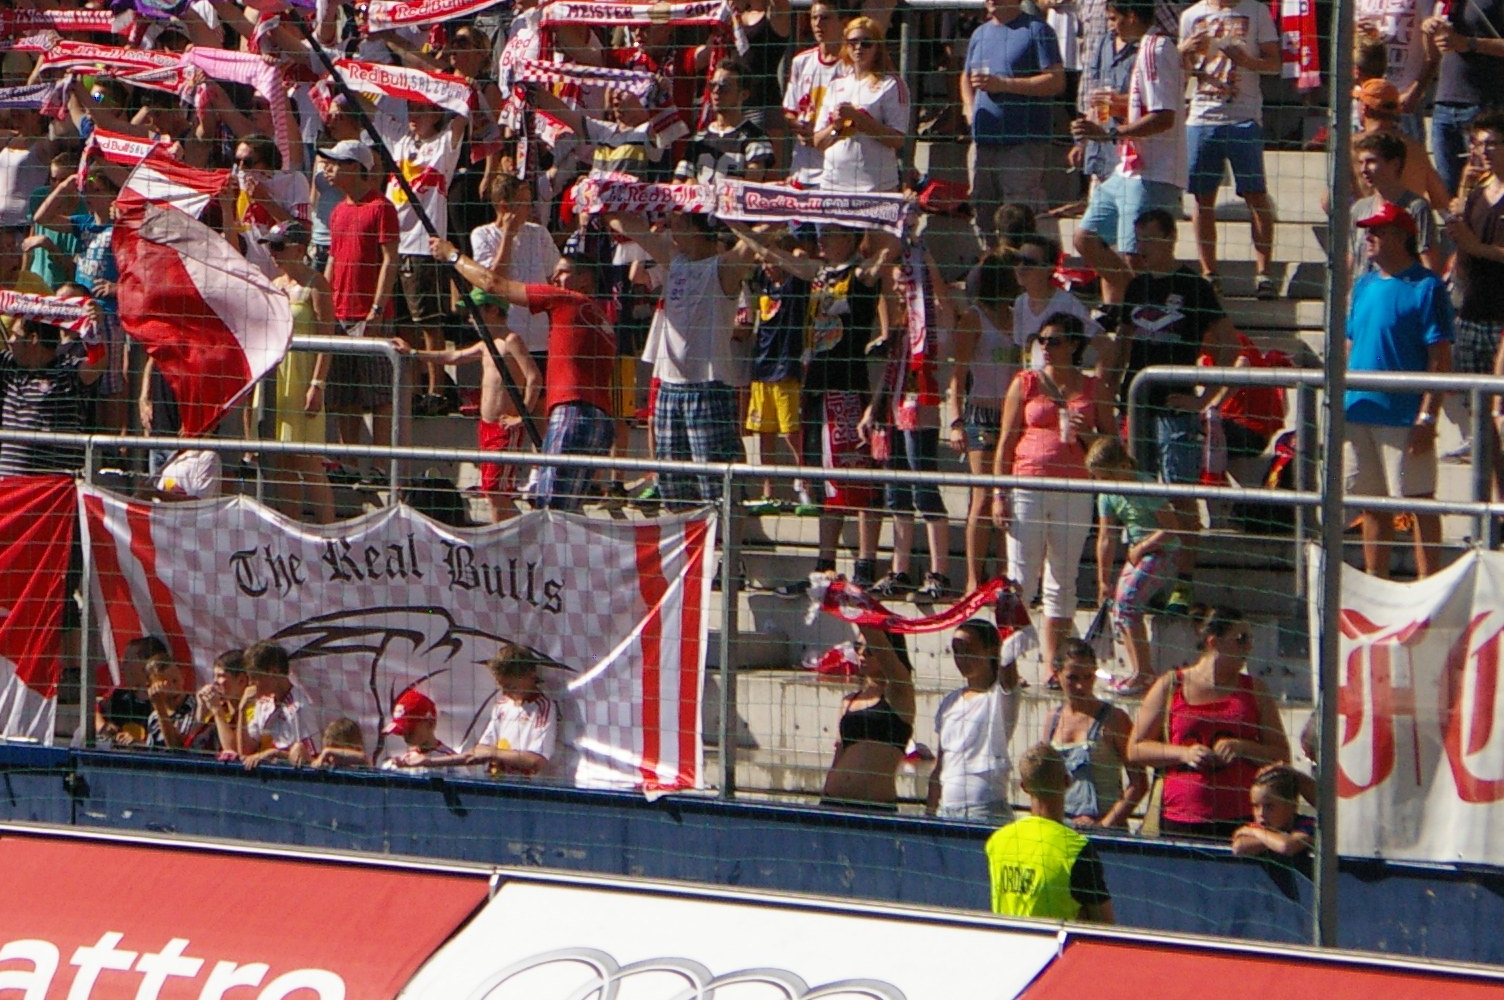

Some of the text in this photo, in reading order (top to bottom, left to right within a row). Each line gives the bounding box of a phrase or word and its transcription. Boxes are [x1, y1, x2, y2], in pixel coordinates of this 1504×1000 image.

[228, 531, 567, 616] The Real Bulls
